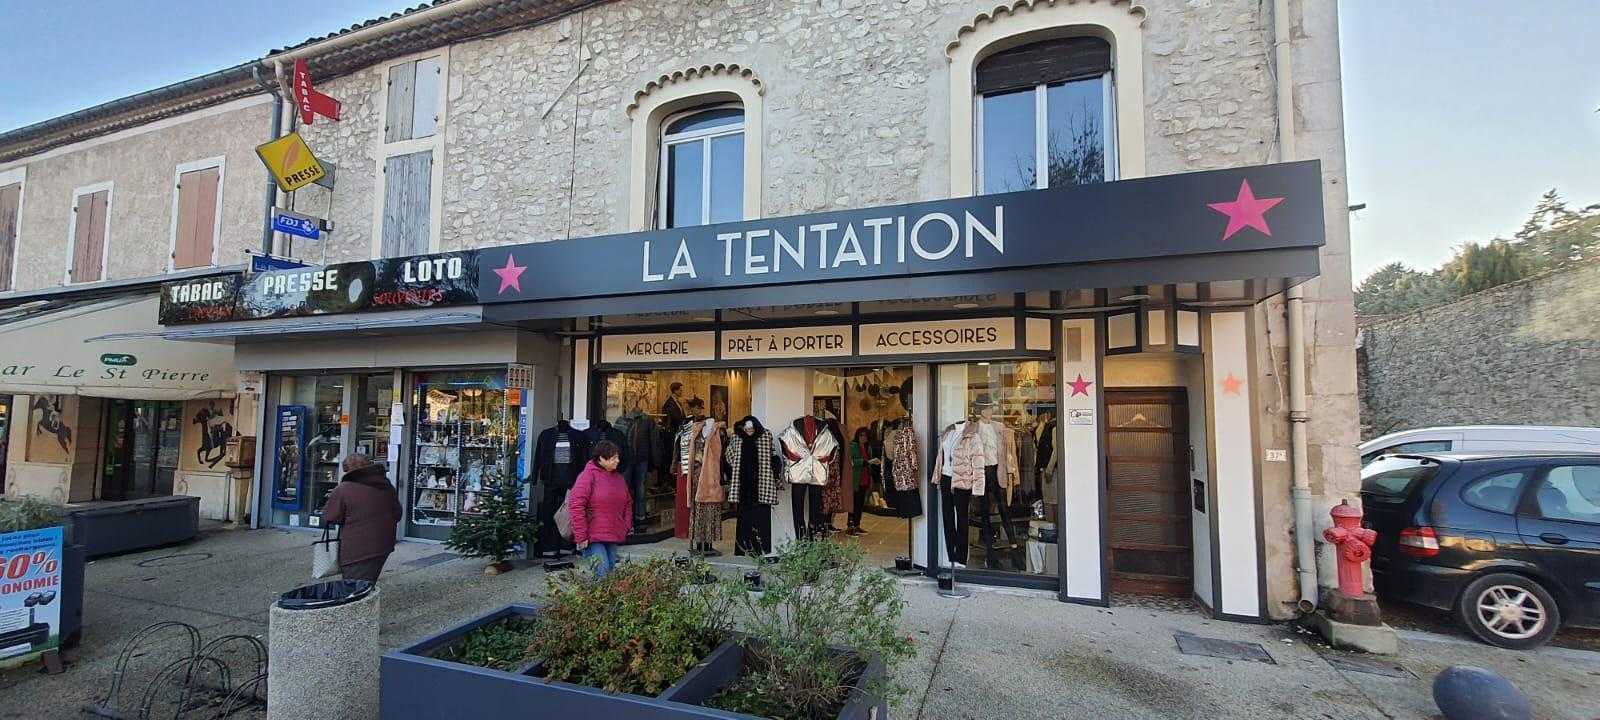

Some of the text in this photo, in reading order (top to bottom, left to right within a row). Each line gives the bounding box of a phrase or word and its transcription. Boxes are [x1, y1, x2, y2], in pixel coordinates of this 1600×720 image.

[298, 71, 310, 112] TABAC
[285, 164, 321, 187] PRESSE
[280, 216, 299, 227] FDJ
[641, 205, 1005, 282] LA TENTATION
[404, 257, 462, 283] LOTO
[171, 281, 224, 303] TABAC
[263, 269, 339, 295] PRESSE
[625, 340, 689, 356] MERCERIE
[728, 334, 844, 353] PRÊT À PORTER
[875, 326, 997, 348] ACCESSOIRES
[0, 365, 210, 382] ar Le St Pierre
[0, 575, 59, 594] ONOMIE
